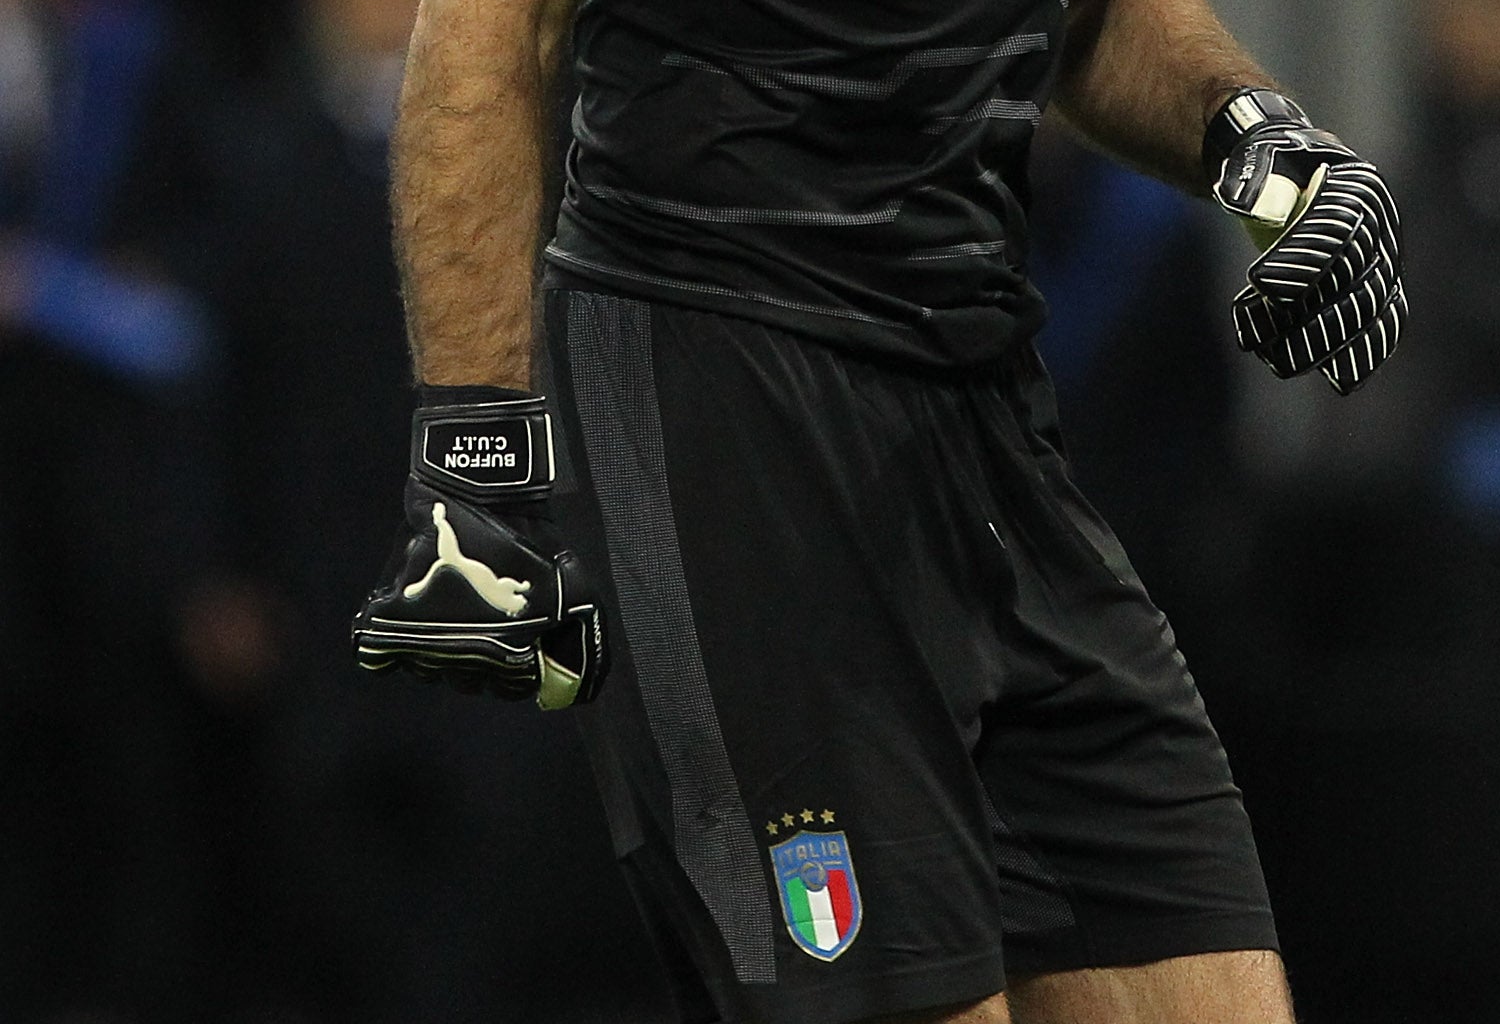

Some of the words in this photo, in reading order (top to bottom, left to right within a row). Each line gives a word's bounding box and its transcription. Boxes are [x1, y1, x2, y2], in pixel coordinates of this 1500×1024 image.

[452, 436, 508, 451] C.U.I.T
[445, 453, 516, 469] BUFFON
[777, 839, 842, 868] ITALIA
